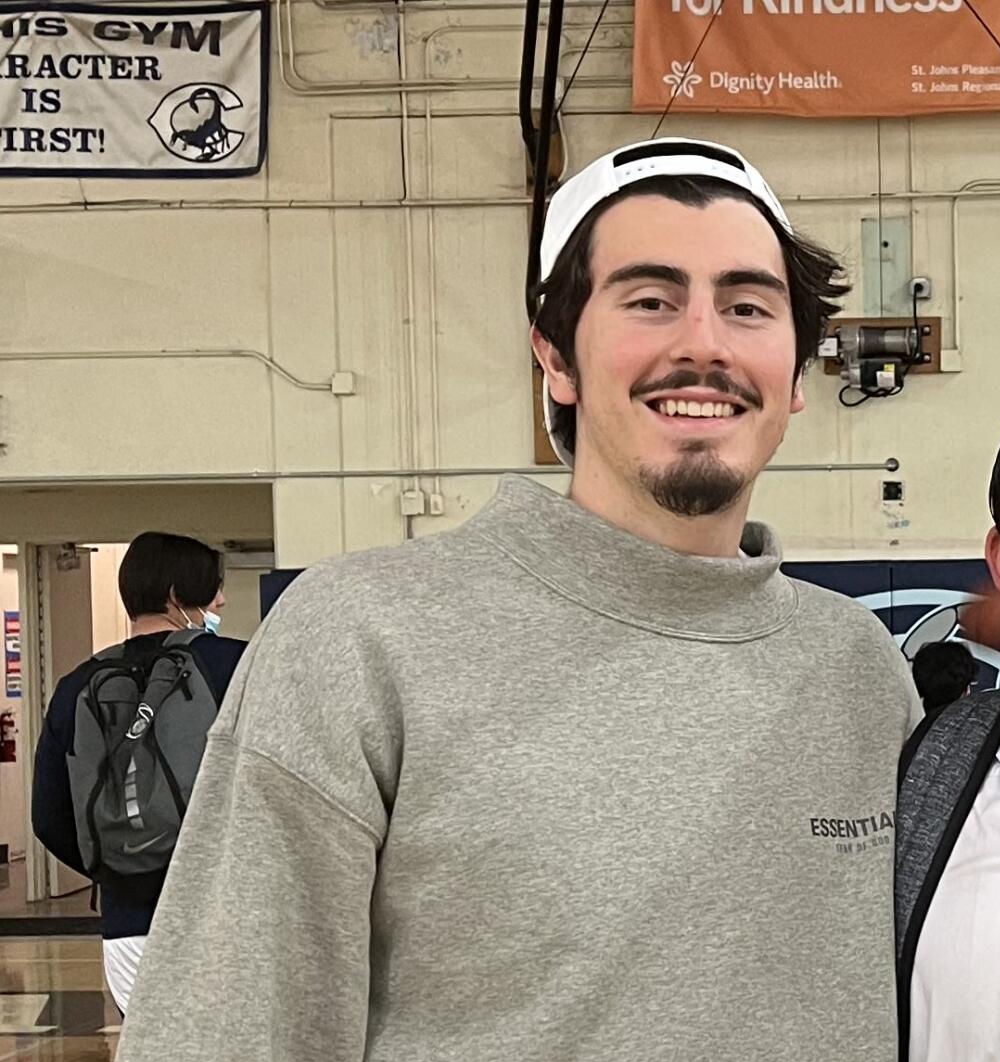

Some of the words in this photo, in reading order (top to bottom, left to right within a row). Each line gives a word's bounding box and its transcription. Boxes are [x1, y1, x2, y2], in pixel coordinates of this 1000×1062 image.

[93, 20, 222, 56] GYM
[0, 54, 162, 80] RACTER
[911, 65, 926, 76] St.
[930, 65, 960, 76] Johns
[709, 71, 774, 95] Dignity
[778, 70, 838, 89] Health
[911, 82, 926, 93] St.
[930, 82, 960, 93] Johns
[21, 88, 62, 113] IS
[0, 127, 105, 154] IRST!
